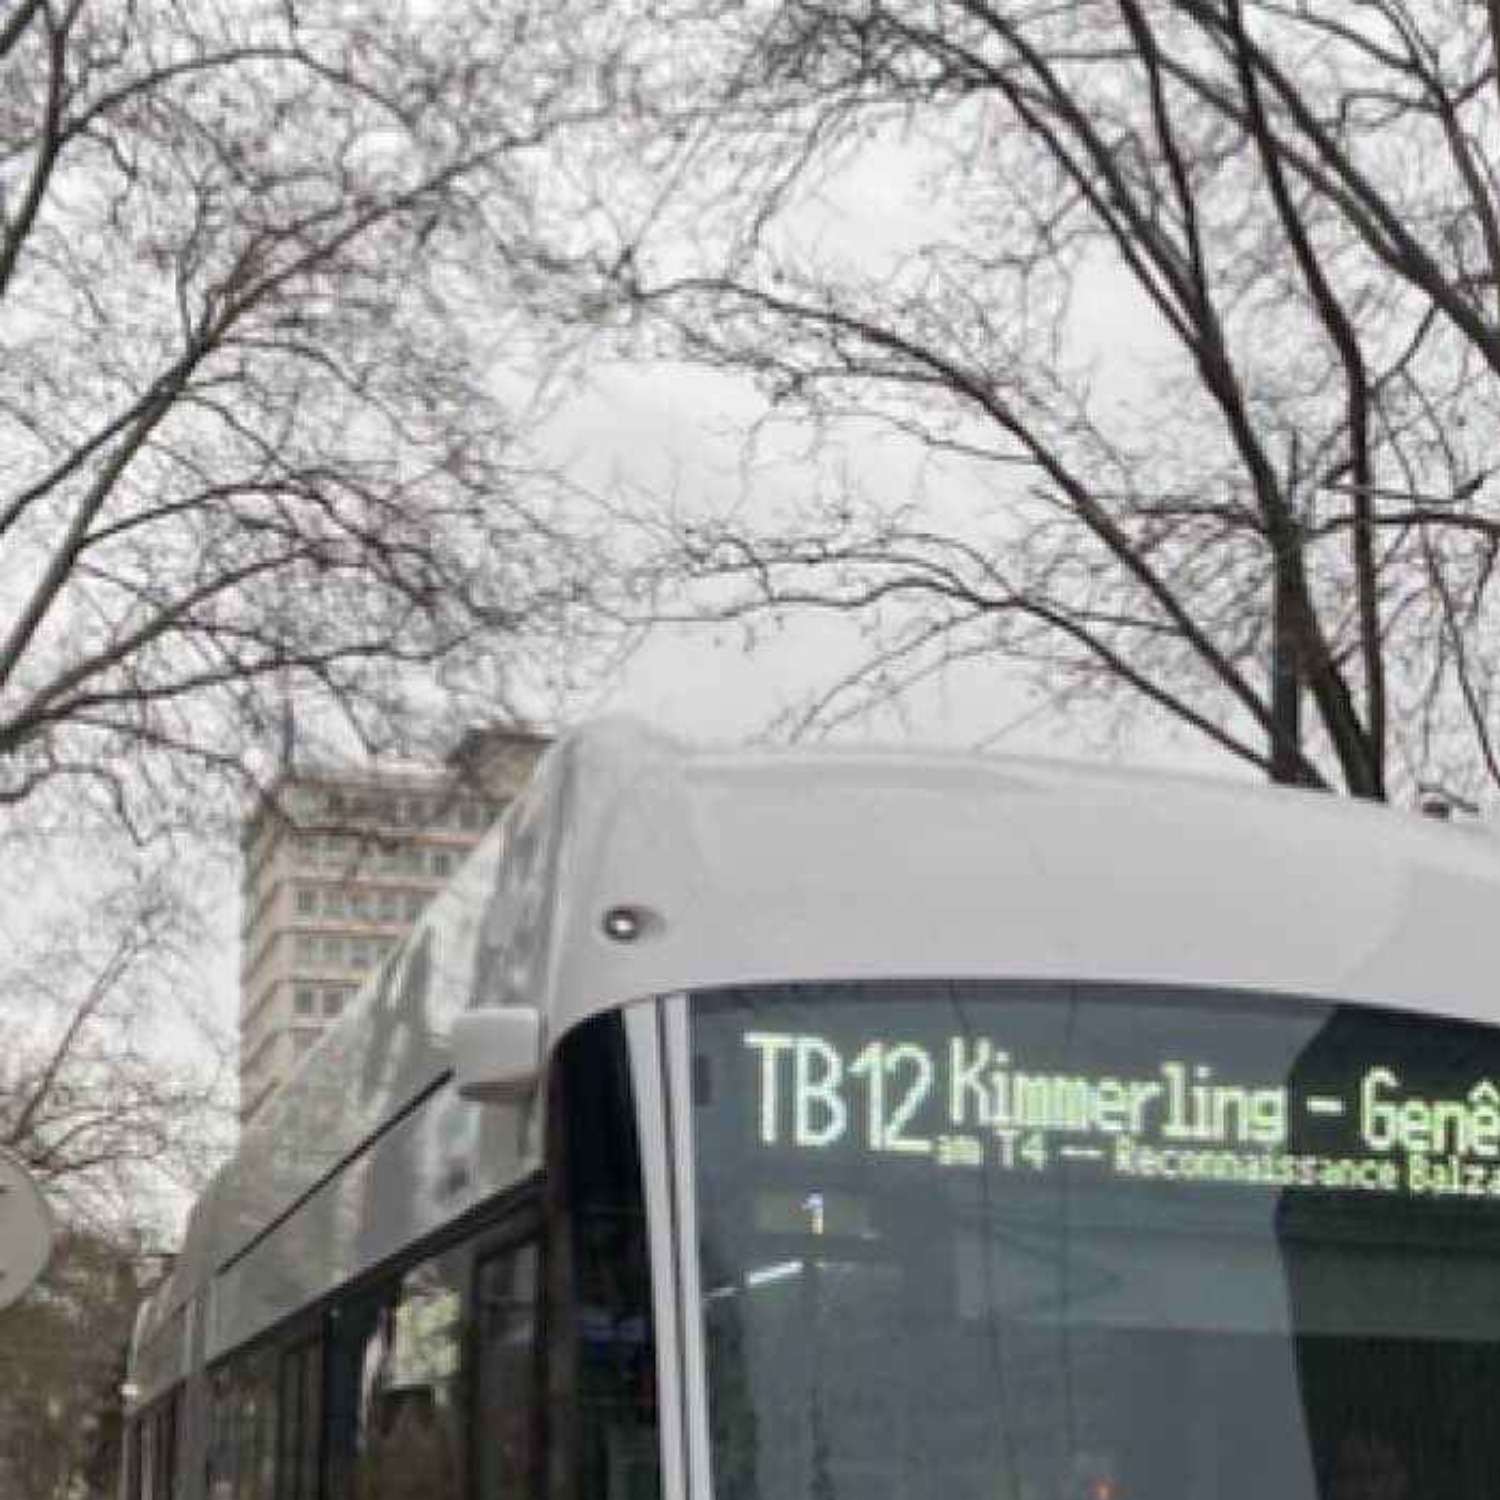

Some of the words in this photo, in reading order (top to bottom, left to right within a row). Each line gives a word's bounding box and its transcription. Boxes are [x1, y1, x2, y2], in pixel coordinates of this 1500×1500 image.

[743, 1031, 932, 1152] TB12
[950, 1036, 1287, 1145] Kimmerling
[996, 1129, 1046, 1169] T4
